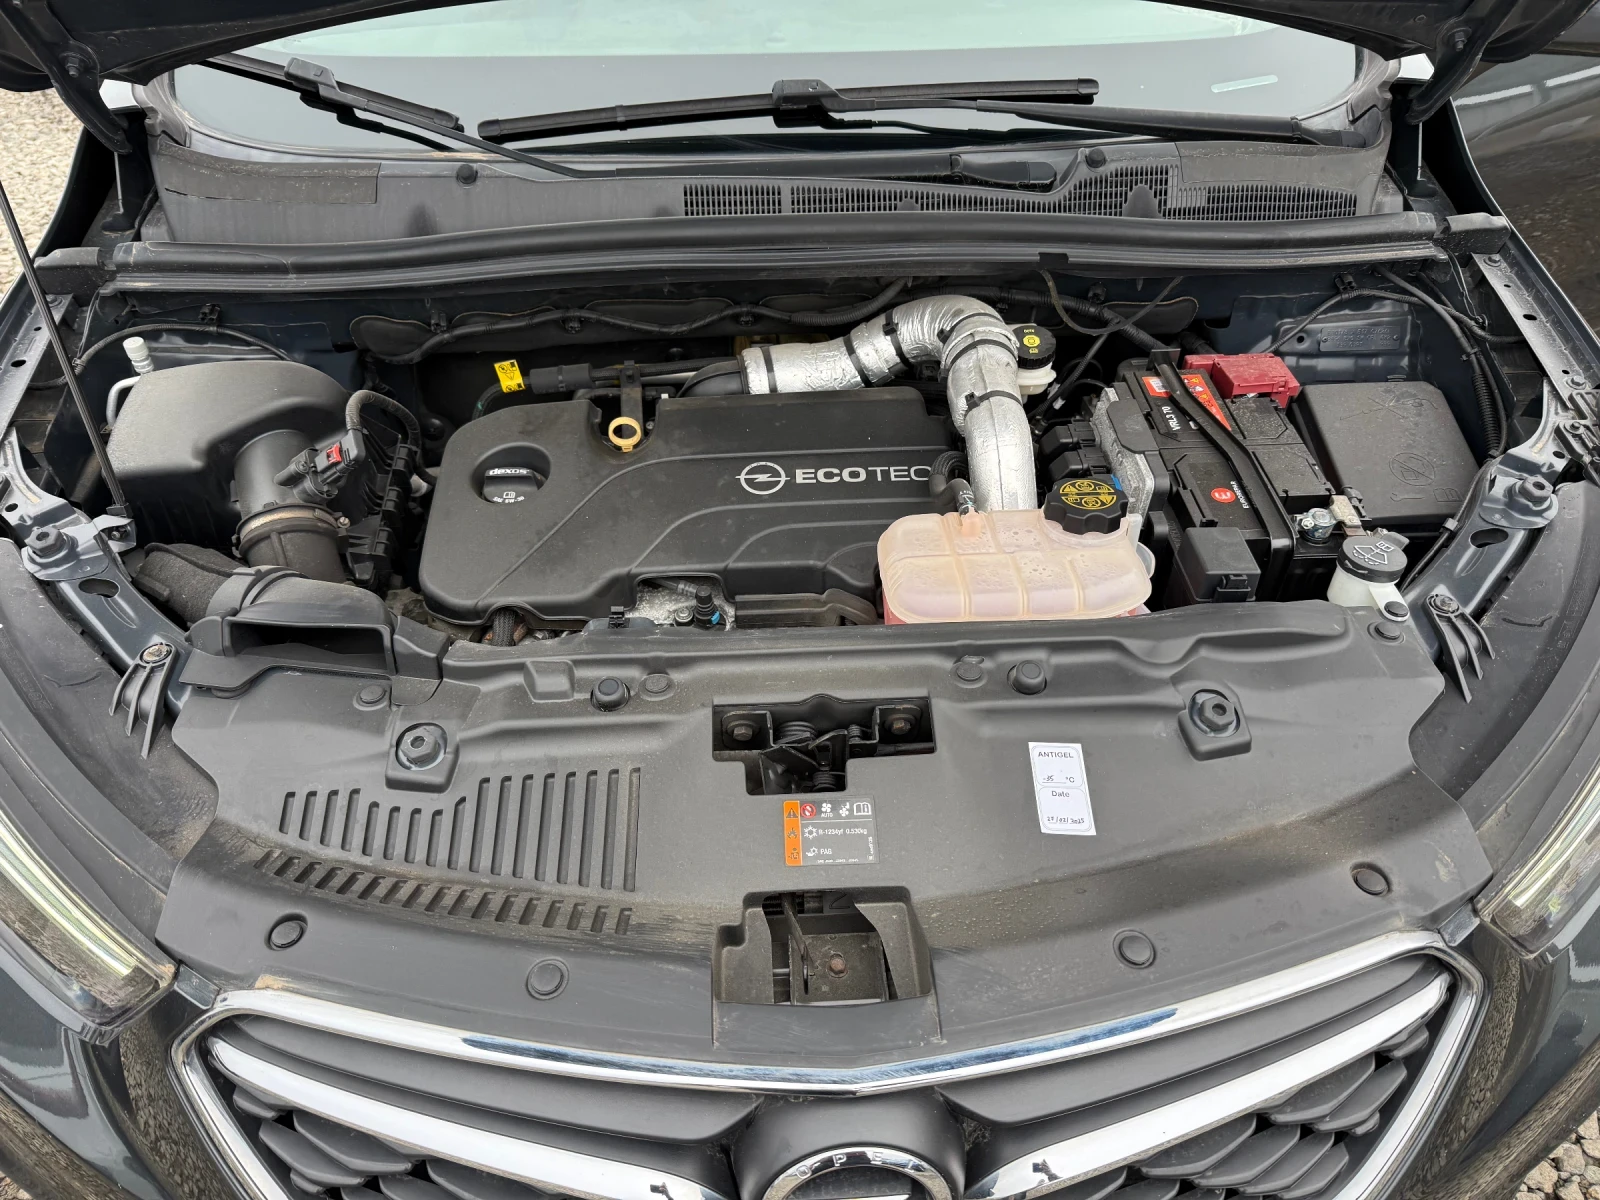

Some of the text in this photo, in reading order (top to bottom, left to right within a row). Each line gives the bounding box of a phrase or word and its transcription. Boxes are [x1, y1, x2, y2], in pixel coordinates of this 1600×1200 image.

[795, 465, 932, 484] ECOTEC
[1037, 751, 1074, 759] ANTIGEL
[1051, 790, 1070, 798] Date
[795, 1151, 917, 1179] OPEL
